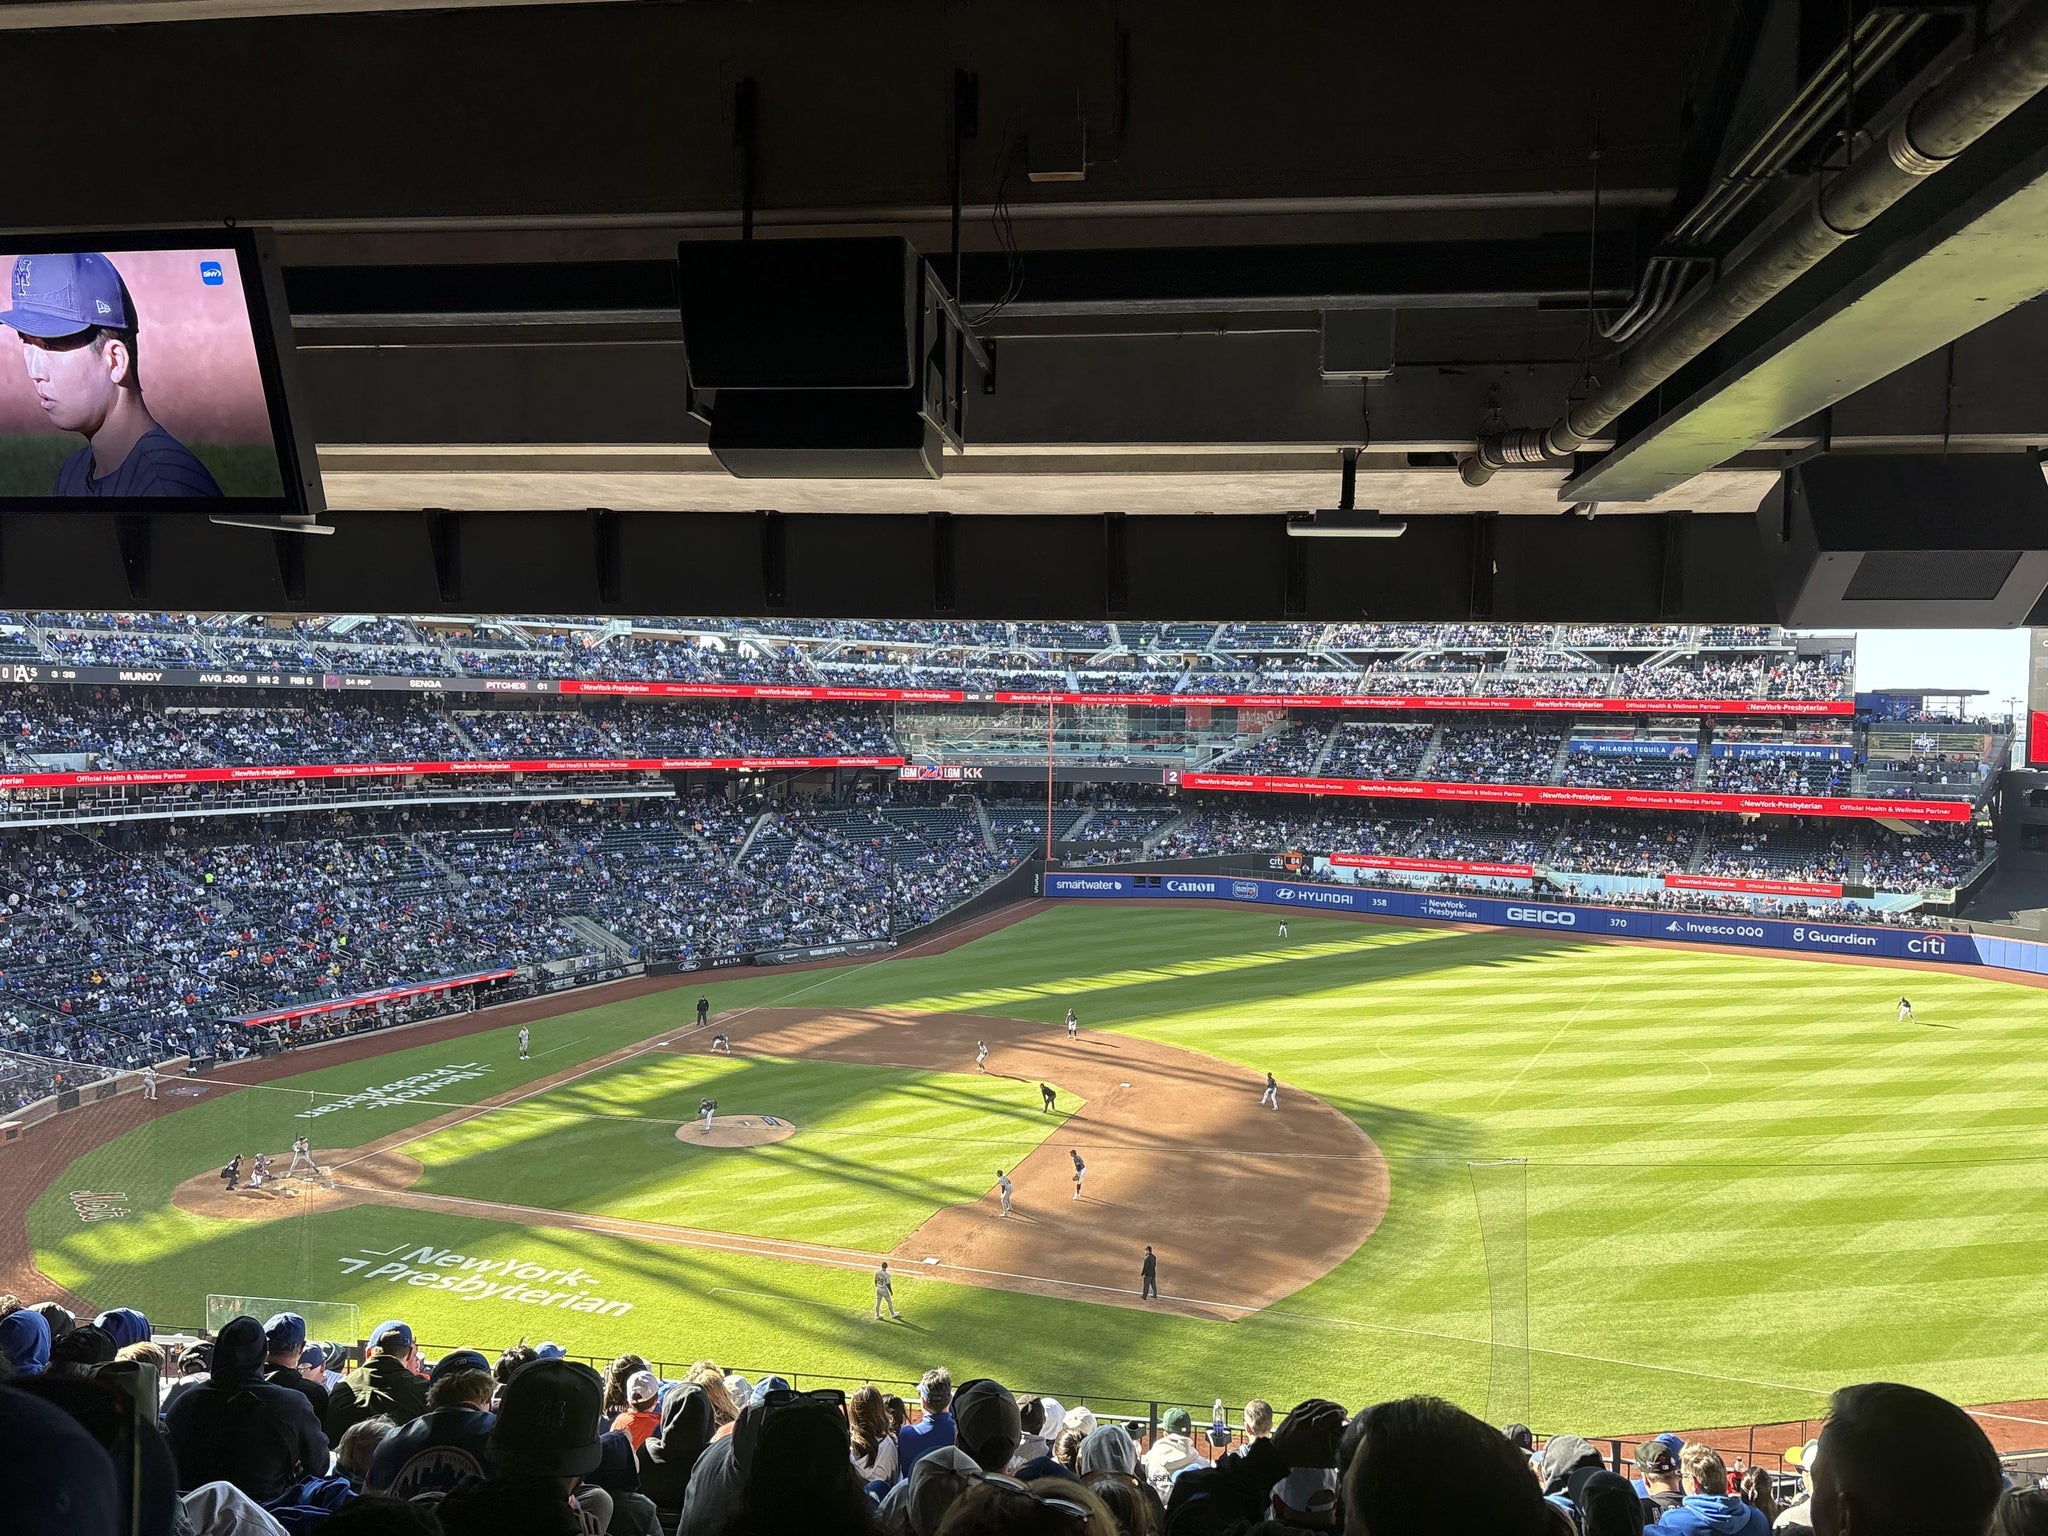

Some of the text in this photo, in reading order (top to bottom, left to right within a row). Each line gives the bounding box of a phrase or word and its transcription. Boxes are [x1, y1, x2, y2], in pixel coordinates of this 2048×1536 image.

[223, 675, 247, 683] .308
[257, 676, 279, 684] HR 2
[410, 680, 442, 688] SENGA
[486, 682, 526, 690] PITCHES
[584, 684, 649, 693] NewYork-Presbyterian
[901, 767, 917, 777] LGM
[944, 767, 960, 777] LGM
[964, 767, 983, 778] KK
[1169, 772, 1178, 782] 2
[1361, 785, 1423, 793] NewYork-Presbyterian
[1543, 792, 1611, 800] NewYork-Presbyterian
[1745, 800, 1822, 809] NewYork-Presbyterian
[1270, 857, 1284, 866] citi
[1473, 865, 1528, 874] NewYork-Presbyterian
[1056, 880, 1113, 890] smartwater
[1167, 880, 1215, 892] Canon
[1299, 890, 1353, 905] HYUNDAI
[1372, 898, 1387, 907] 358
[1429, 899, 1467, 909] NewYork-
[1429, 906, 1477, 919] Presbyterian
[1507, 907, 1576, 925] GEICO
[1610, 919, 1627, 928] 370
[1687, 922, 1764, 938] Invesco QQQ
[1809, 930, 1877, 946] Guardian
[1908, 936, 1946, 954] citi
[400, 1245, 602, 1287] NewYork-
[363, 1261, 635, 1317] Presbyterian
